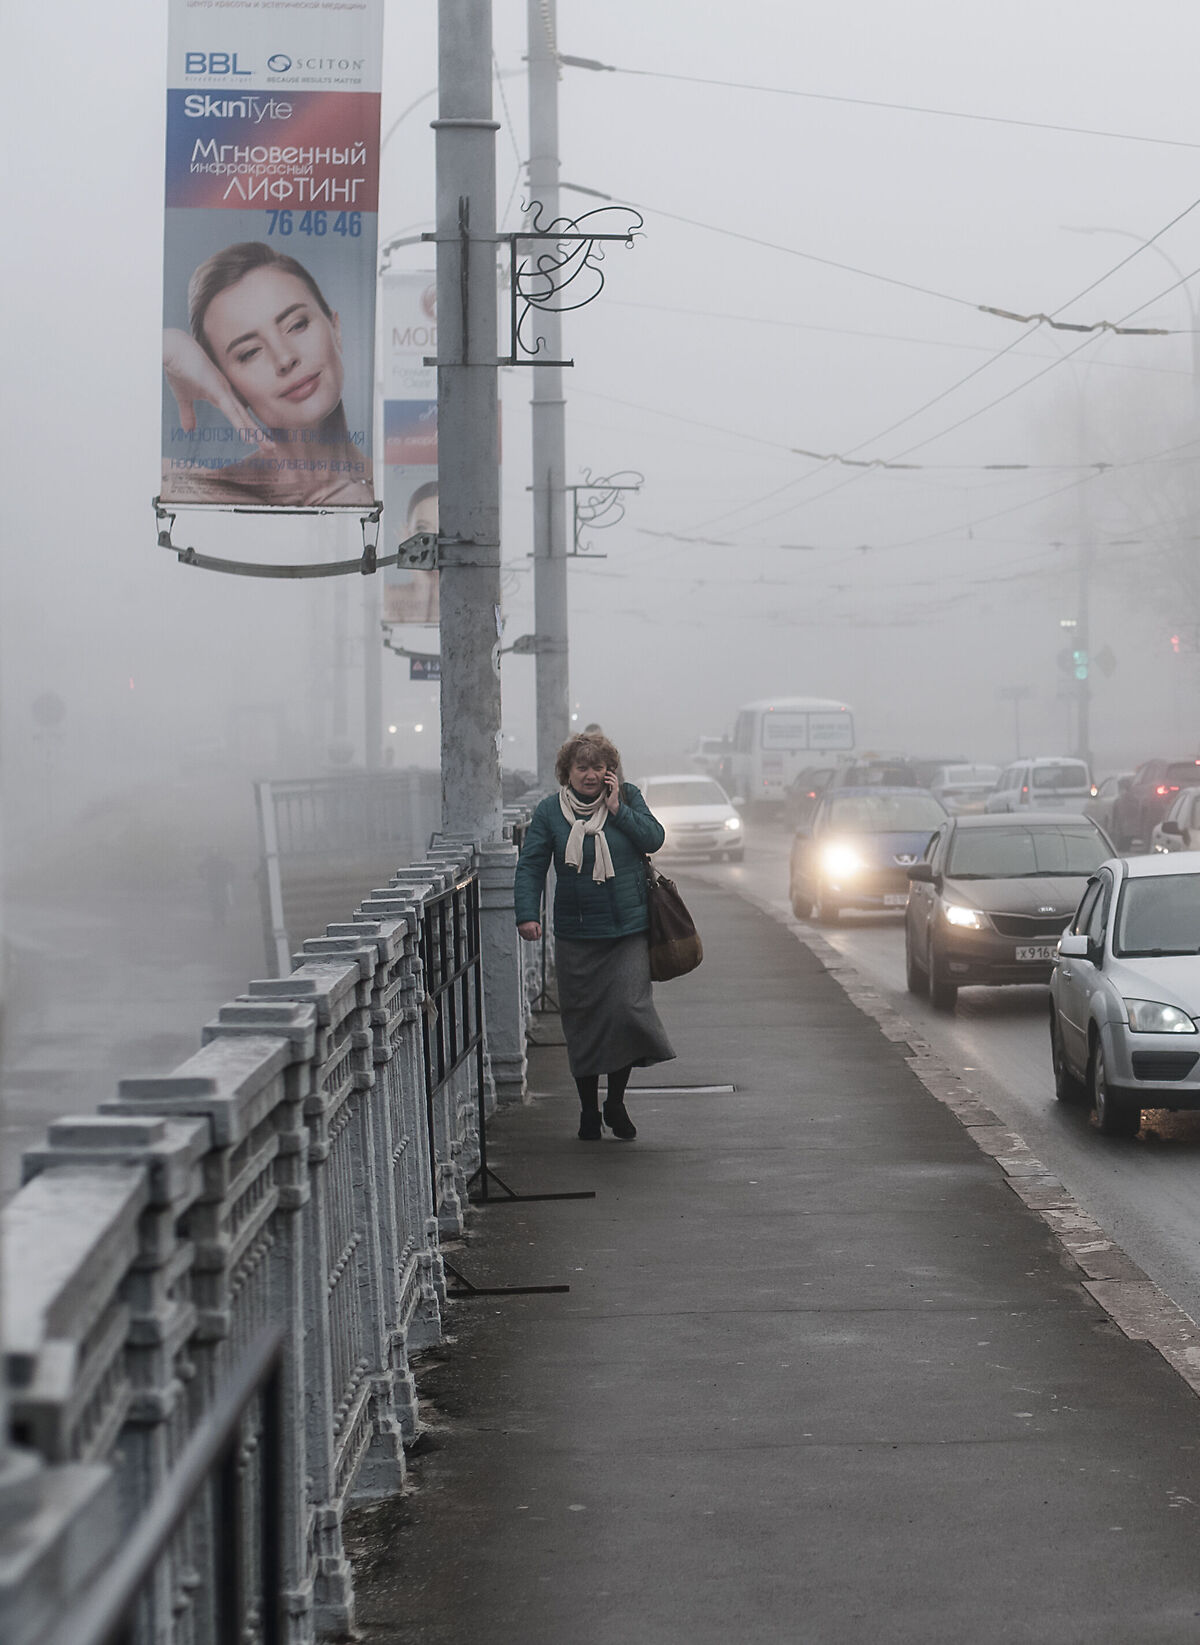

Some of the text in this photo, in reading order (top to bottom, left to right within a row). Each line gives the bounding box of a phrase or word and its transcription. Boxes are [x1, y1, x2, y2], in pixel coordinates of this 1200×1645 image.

[185, 52, 253, 75] BBL
[296, 58, 361, 70] SCITON
[184, 94, 293, 124] SkinTyte
[192, 138, 366, 165] Мгновенный
[190, 160, 313, 177] инфракрасный
[223, 176, 365, 203] ЛИФТИНГ
[266, 209, 362, 237] 76 46 46
